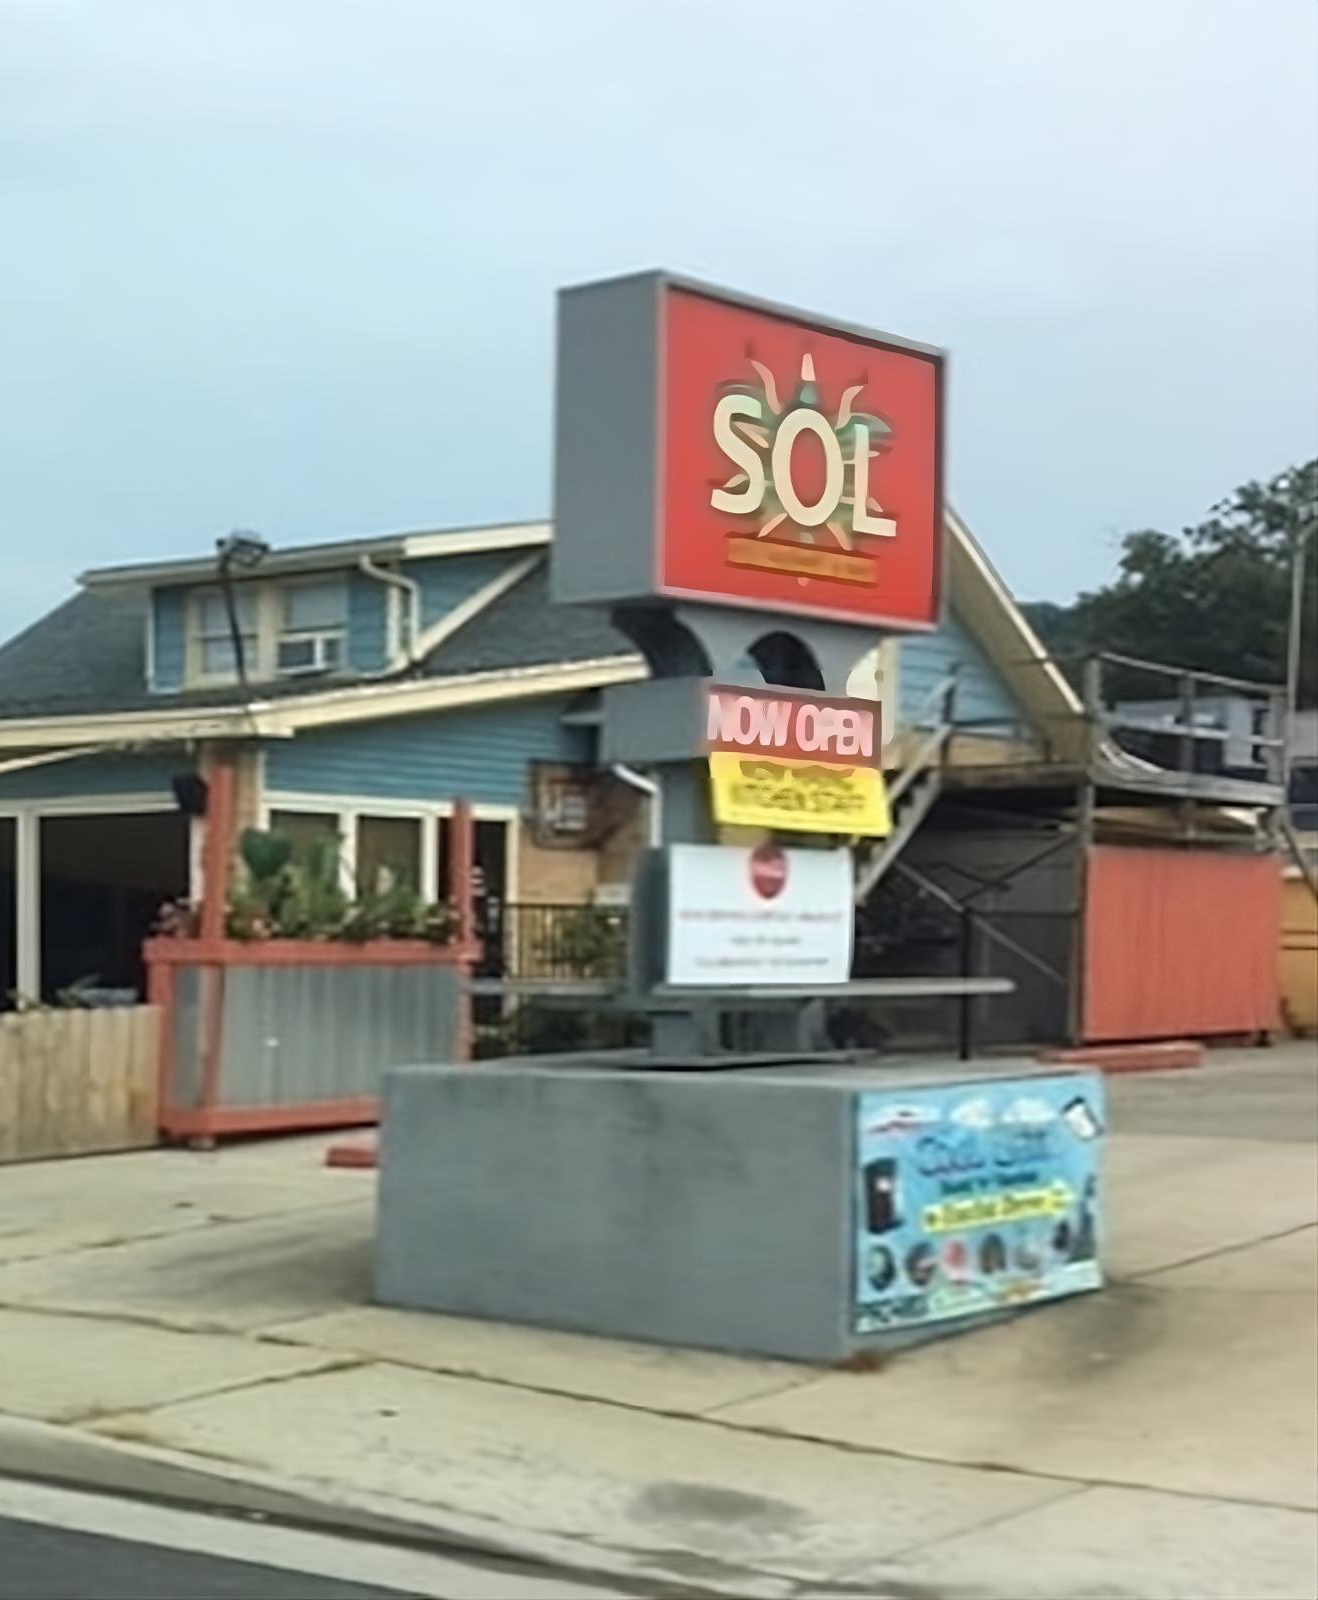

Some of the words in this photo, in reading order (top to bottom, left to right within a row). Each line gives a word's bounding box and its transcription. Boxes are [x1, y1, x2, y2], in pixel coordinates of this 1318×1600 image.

[710, 394, 897, 537] SOL
[707, 695, 793, 747] NOW
[795, 704, 874, 757] OPEN
